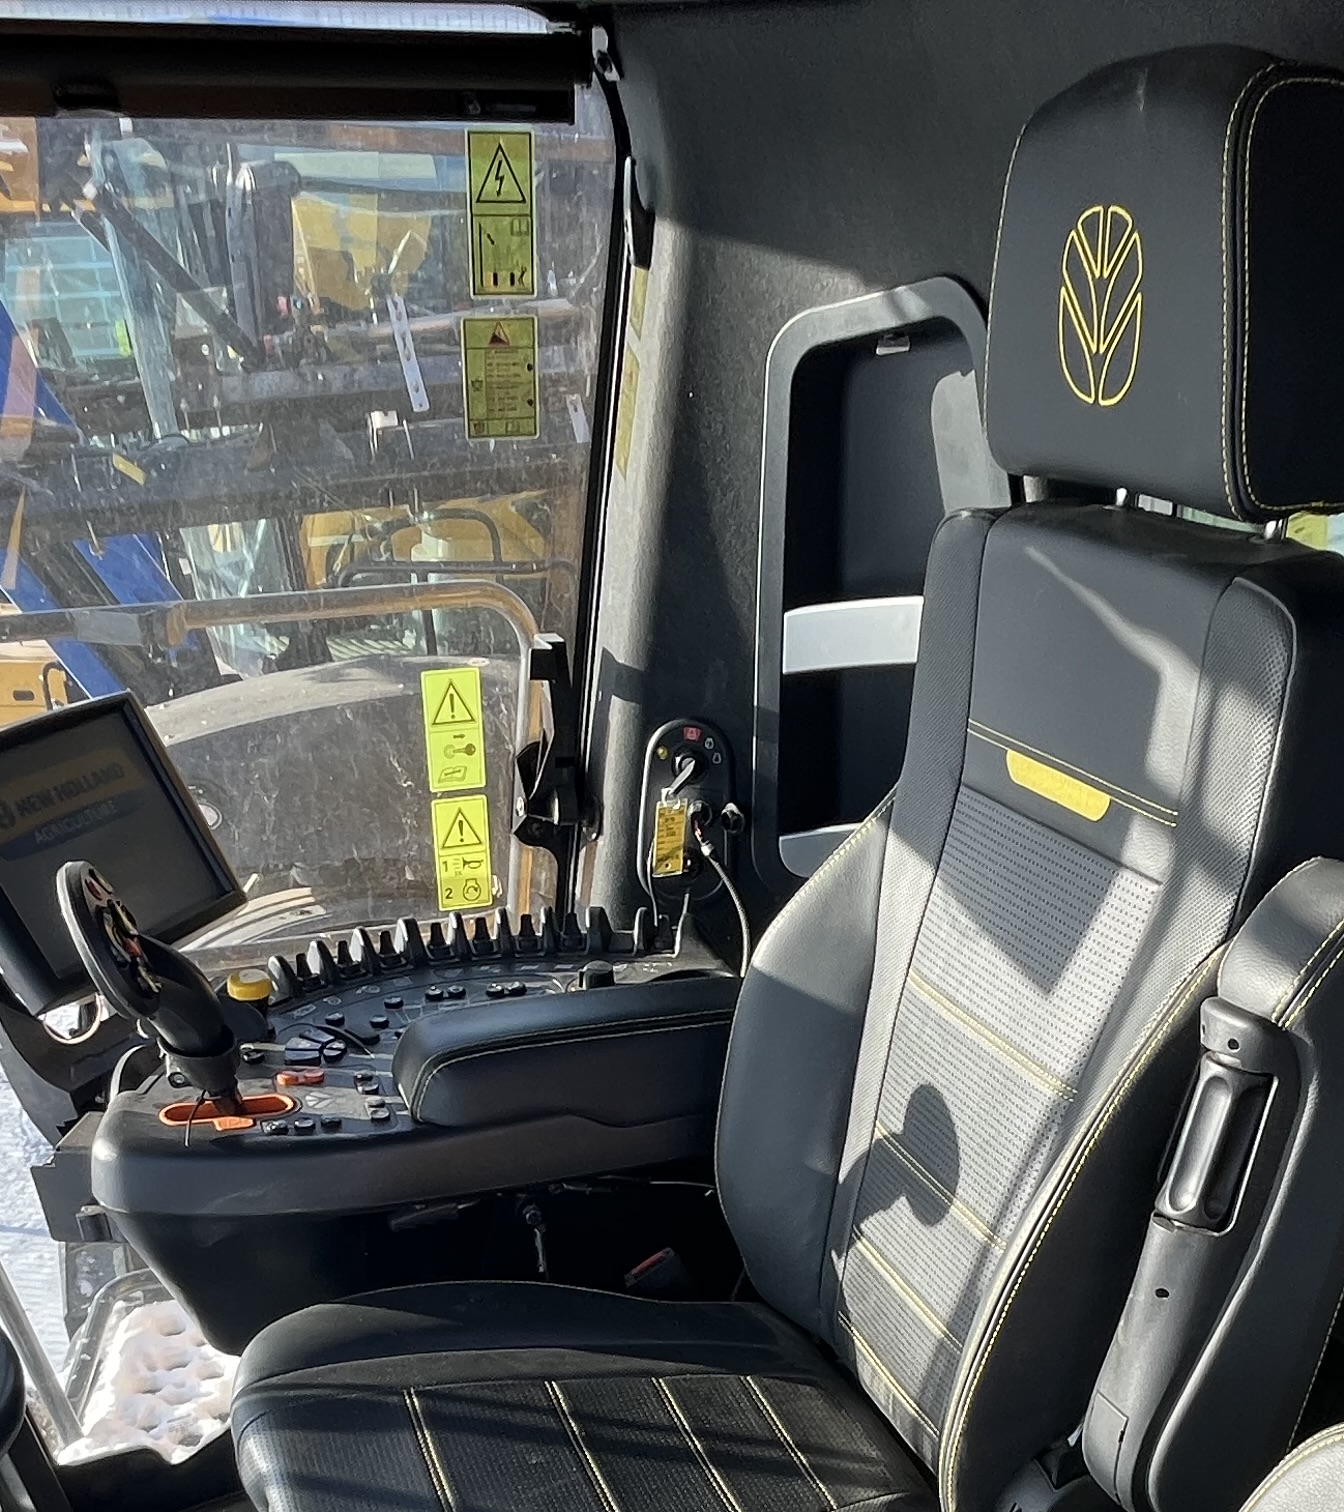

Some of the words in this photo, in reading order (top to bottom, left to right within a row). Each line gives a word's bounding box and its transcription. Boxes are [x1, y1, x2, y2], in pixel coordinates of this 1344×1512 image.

[15, 790, 55, 817] NEW
[54, 763, 124, 801] HOLLAND
[34, 800, 118, 844] AGRICULTURE
[442, 860, 448, 872] 1
[445, 887, 453, 899] 2
